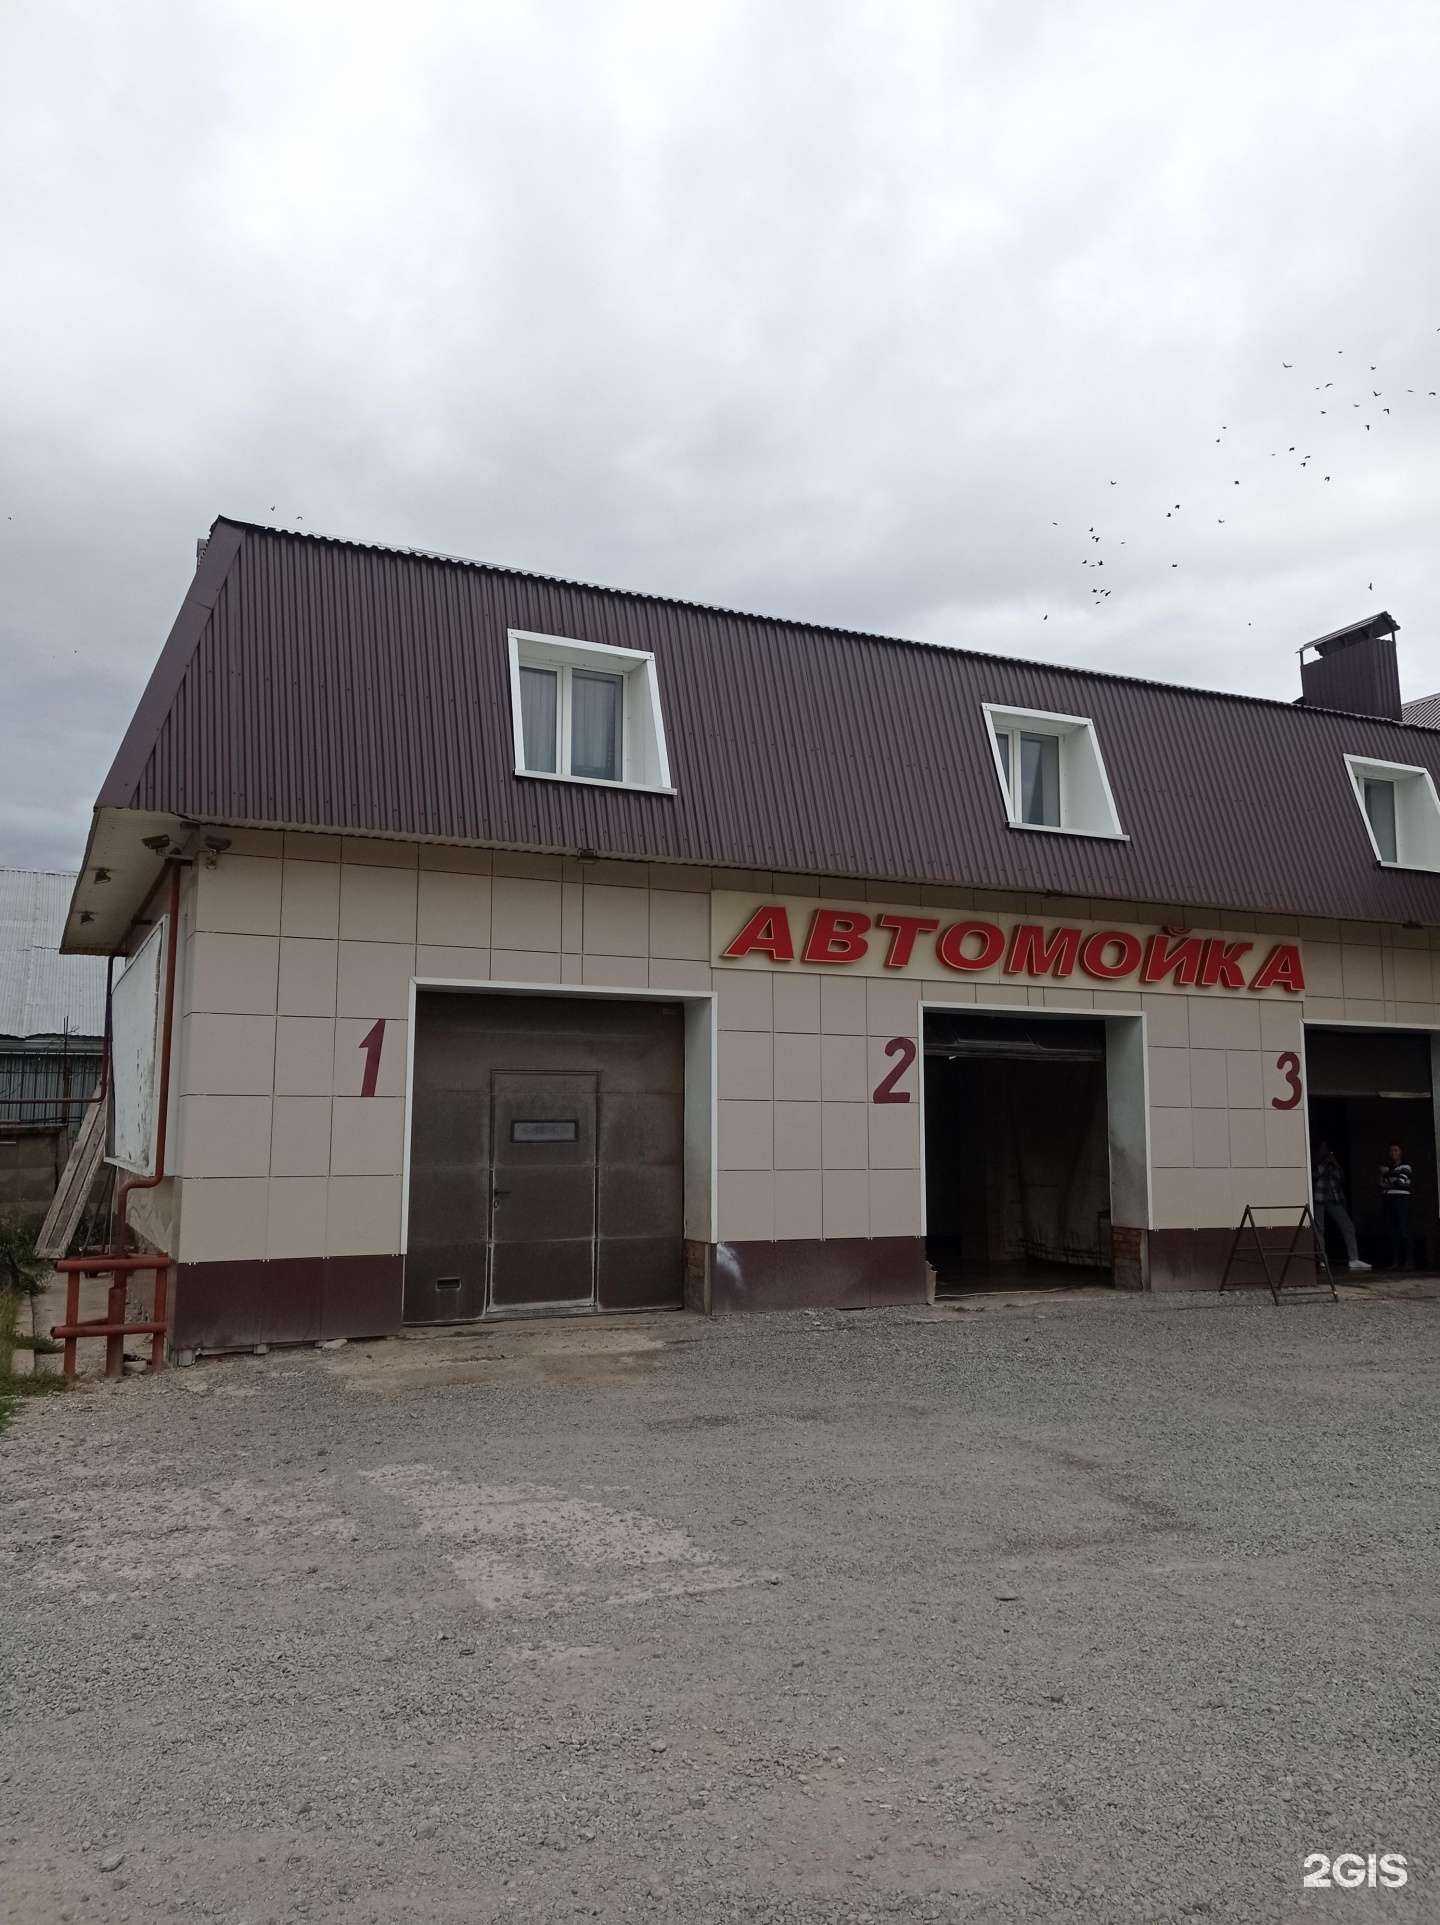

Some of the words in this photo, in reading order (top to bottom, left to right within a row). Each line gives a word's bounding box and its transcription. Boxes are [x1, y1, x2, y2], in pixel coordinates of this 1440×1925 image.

[724, 905, 1306, 994] АВТОМОЙКА
[359, 1018, 386, 1098] 1
[872, 1036, 917, 1105] 2
[1271, 1051, 1302, 1111] 3
